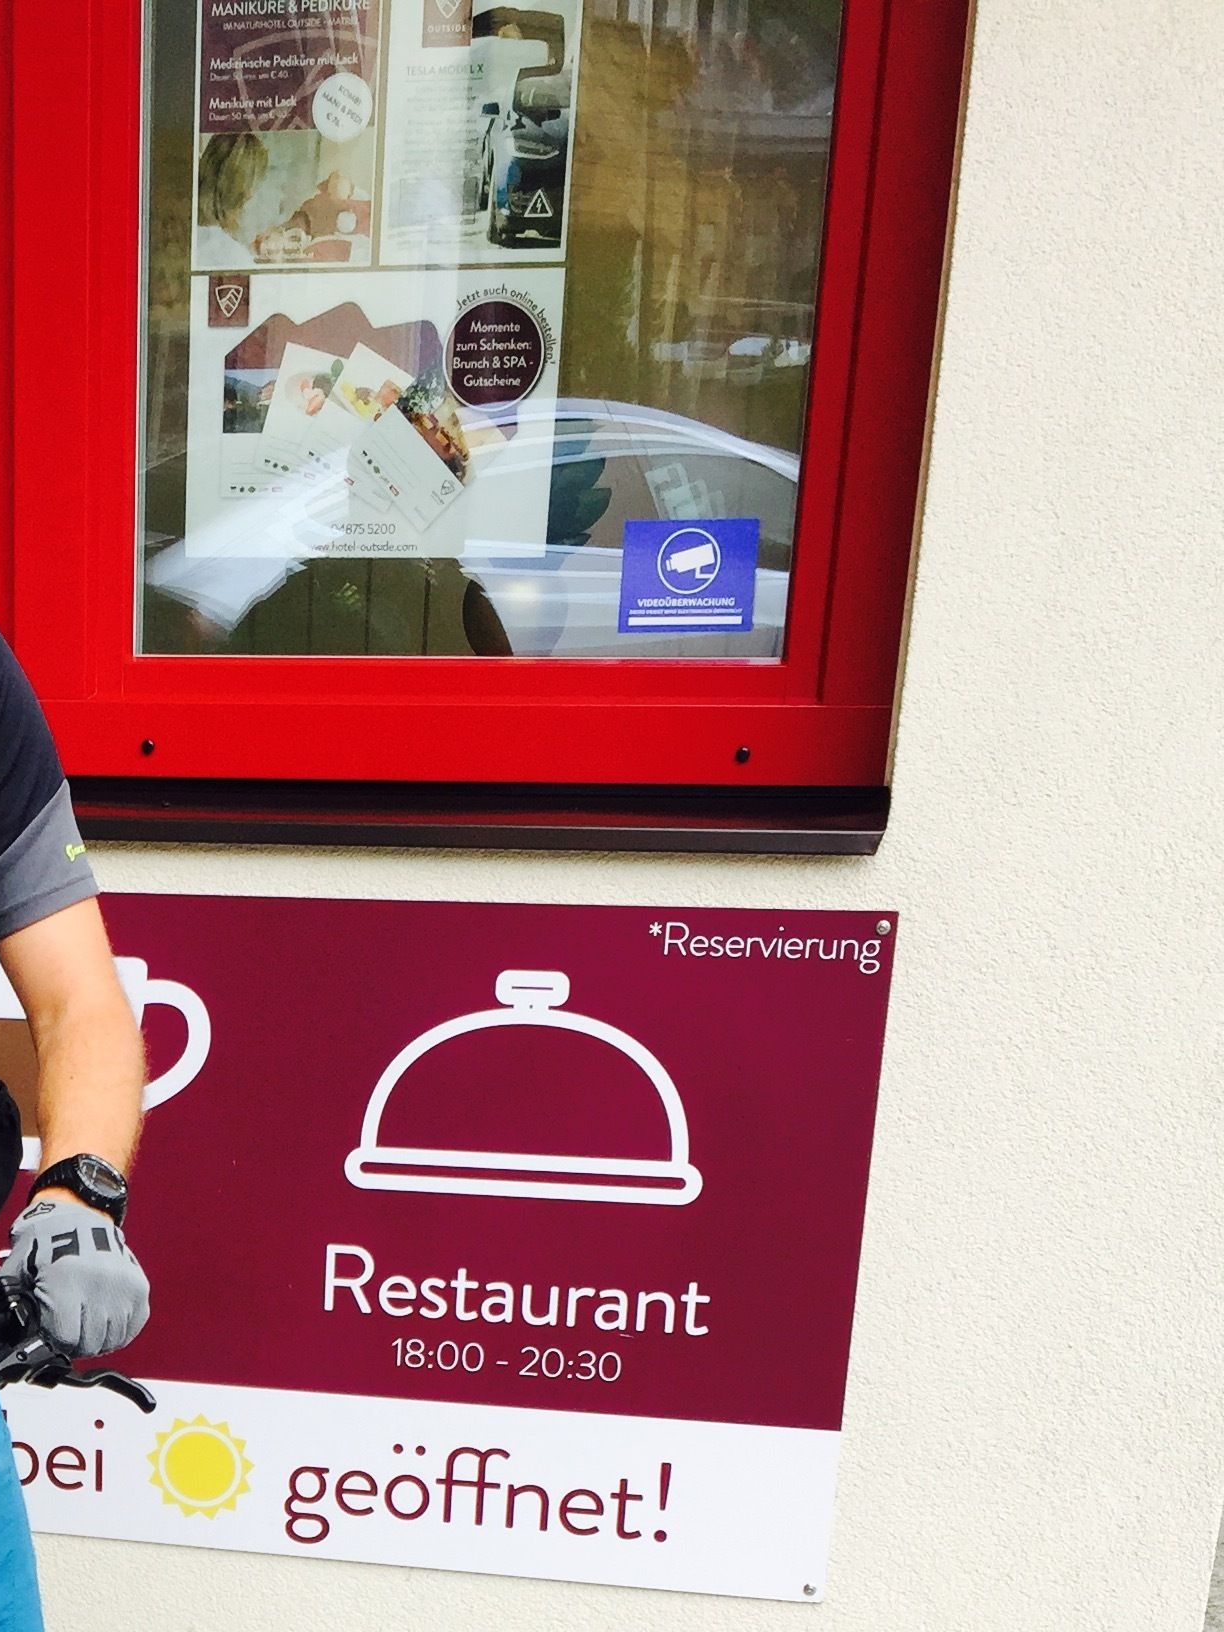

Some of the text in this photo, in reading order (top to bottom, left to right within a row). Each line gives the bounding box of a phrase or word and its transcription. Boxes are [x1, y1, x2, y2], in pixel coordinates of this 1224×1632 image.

[427, 23, 467, 34] OUTSIDE
[210, 52, 358, 71] Medizinische Pediküre mit Lack
[406, 65, 437, 77] TESLA
[477, 63, 484, 74] X
[209, 94, 297, 111] Maniküre mit Lack
[456, 290, 481, 311] Jetzt
[482, 283, 508, 297] auch
[510, 289, 538, 312] online
[470, 320, 521, 333] Momente
[456, 341, 478, 352] zum
[452, 356, 490, 369] Brunch
[491, 357, 501, 369] &
[503, 355, 527, 369] SPA
[463, 373, 521, 387] Gutscheine
[367, 523, 396, 535] 5200
[637, 596, 736, 608] VIDEOÜBERWACHUNG
[323, 1243, 712, 1337] Restaurant
[391, 1337, 485, 1373] 18:00
[518, 1346, 623, 1382] 20:30
[283, 1443, 673, 1544] geöffnet!
